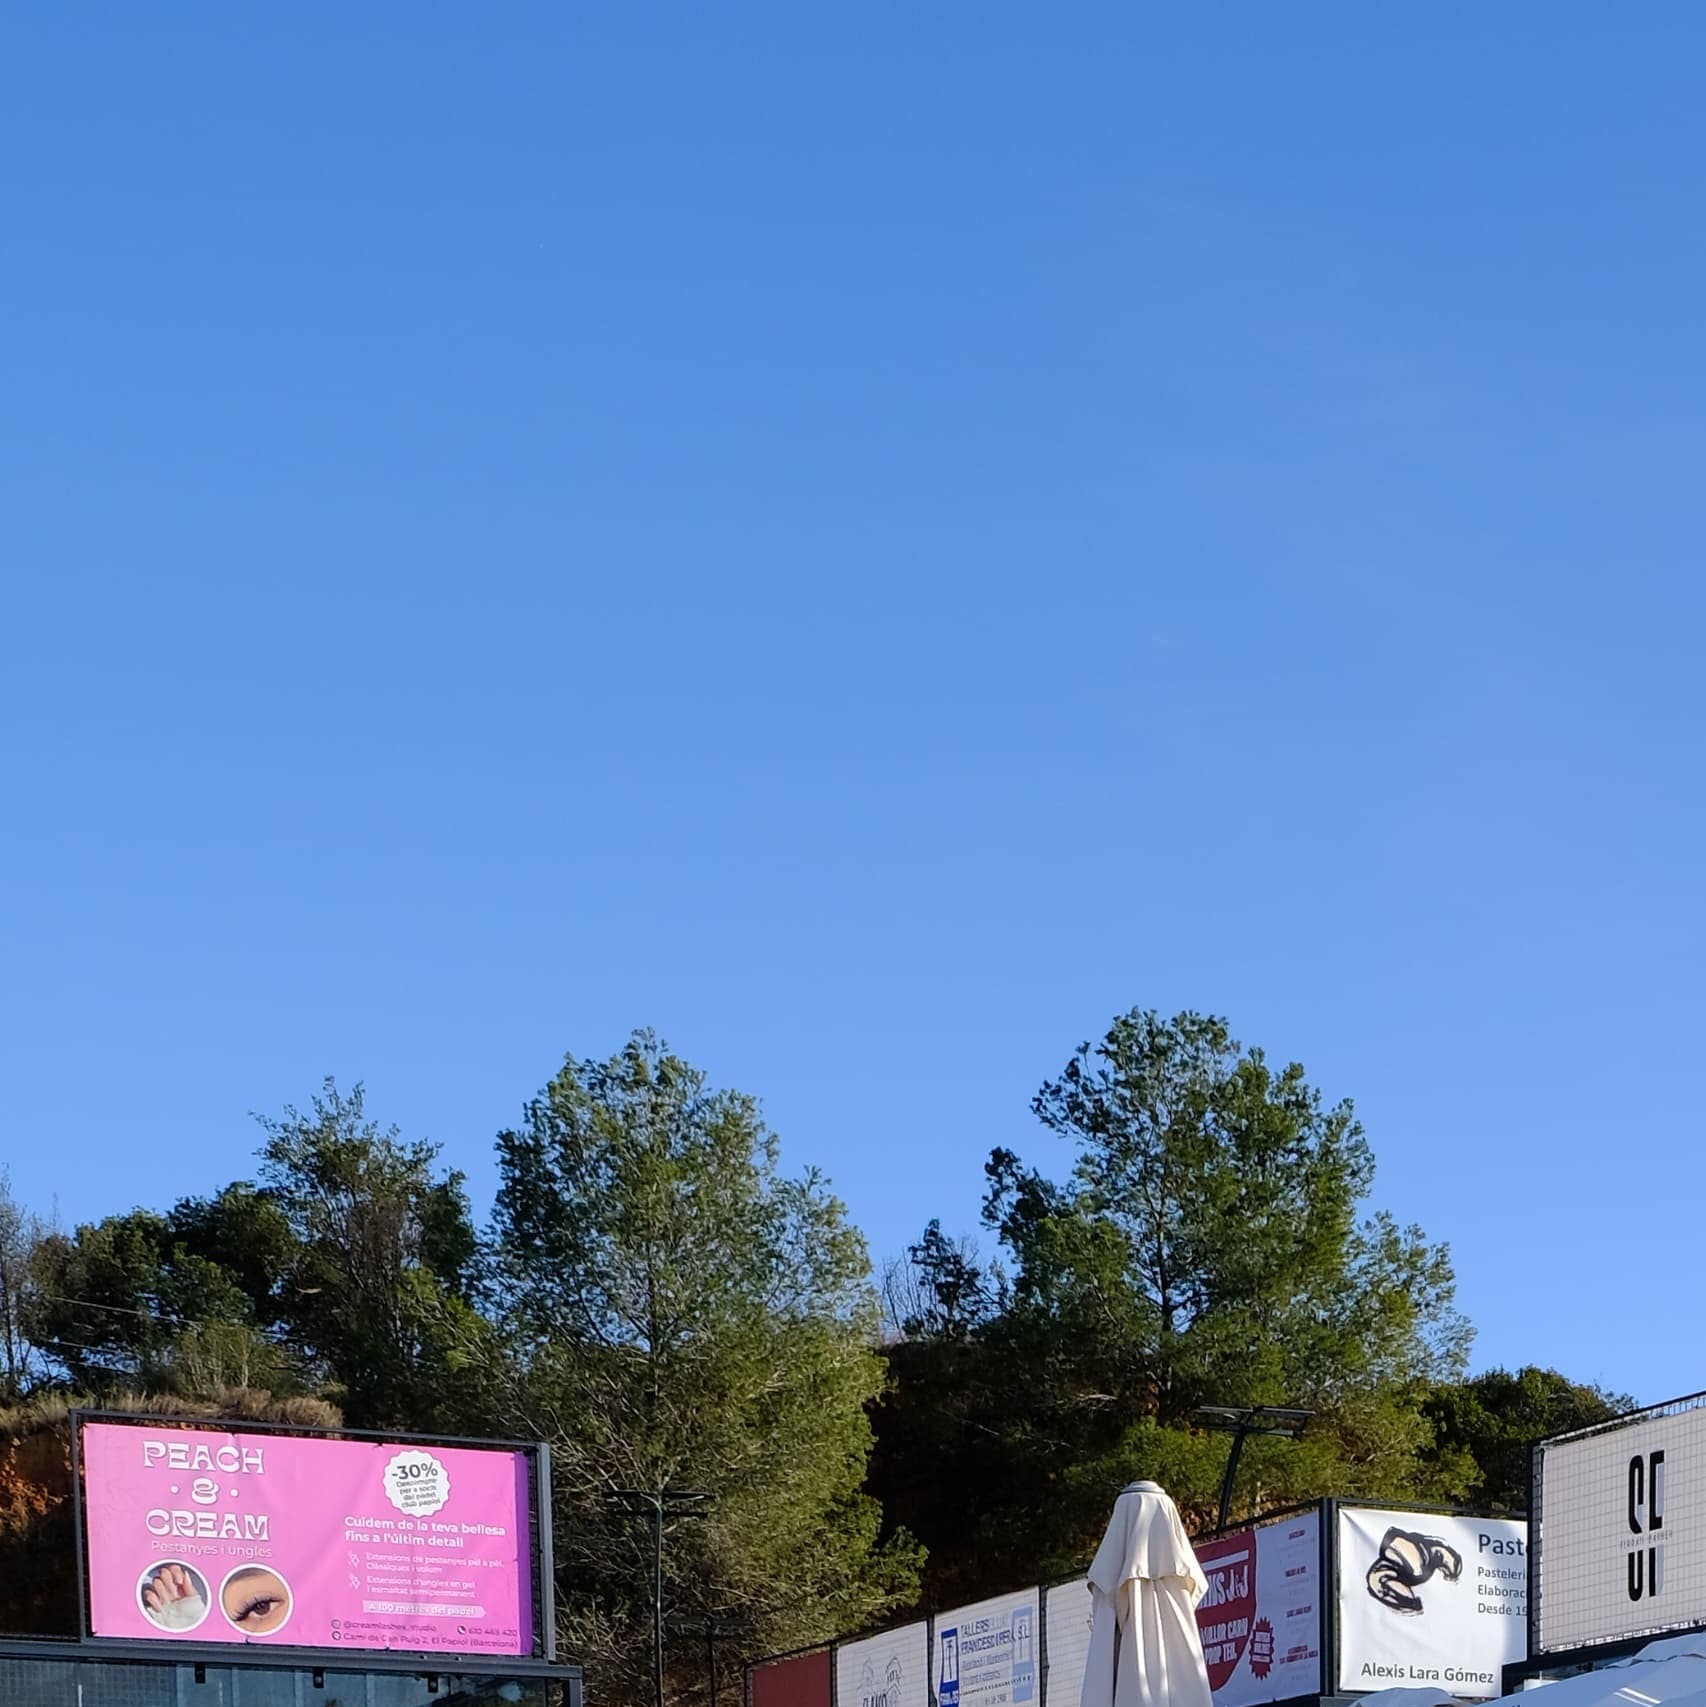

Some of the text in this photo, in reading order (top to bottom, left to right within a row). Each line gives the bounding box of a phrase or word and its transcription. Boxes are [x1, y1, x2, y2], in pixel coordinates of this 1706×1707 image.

[143, 1440, 264, 1474] PEACH
[391, 1462, 439, 1480] -30%
[145, 1509, 270, 1542] CREAM
[344, 1517, 506, 1536] Cuidem de la teva bellesa
[345, 1530, 370, 1542] fins
[428, 1534, 464, 1548] detall
[1478, 1533, 1527, 1555] Past
[151, 1540, 218, 1557] Pestanyes
[228, 1545, 272, 1559] ungles
[1477, 1602, 1513, 1616] Desde
[1361, 1662, 1495, 1684] Alexis Lara Gómez
